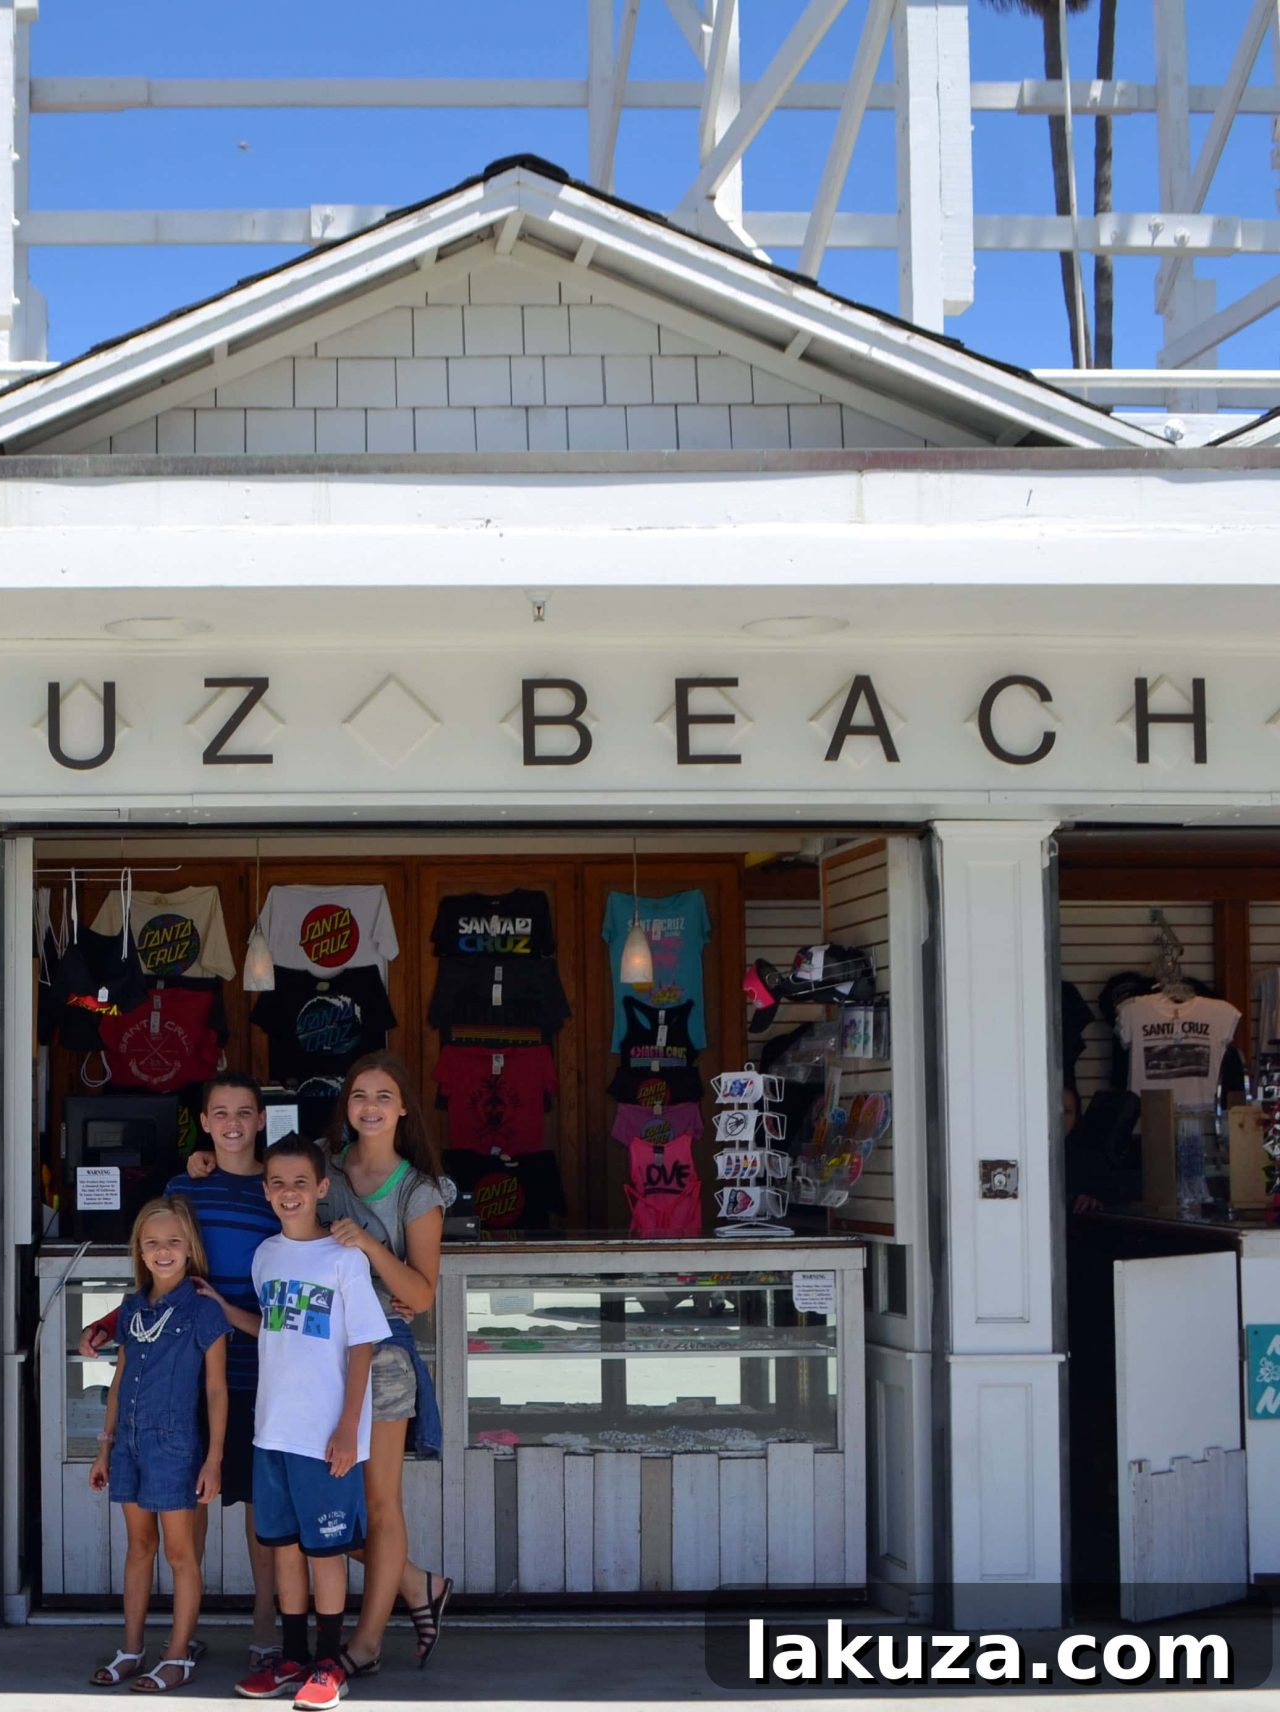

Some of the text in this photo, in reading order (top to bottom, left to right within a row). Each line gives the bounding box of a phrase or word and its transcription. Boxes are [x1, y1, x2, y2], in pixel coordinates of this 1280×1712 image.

[521, 674, 1207, 766] BEACH
[137, 919, 193, 950] SANTA
[300, 908, 351, 945] SANTA
[458, 916, 515, 935] SANTA
[146, 940, 191, 969] CRUZ
[311, 929, 350, 962] CRUZ
[458, 936, 532, 954] CRUZ
[1181, 1021, 1211, 1036] CRUZ
[638, 1160, 690, 1189] LOVE
[476, 1177, 518, 1205] SANTA
[481, 1194, 517, 1220] CRUZ
